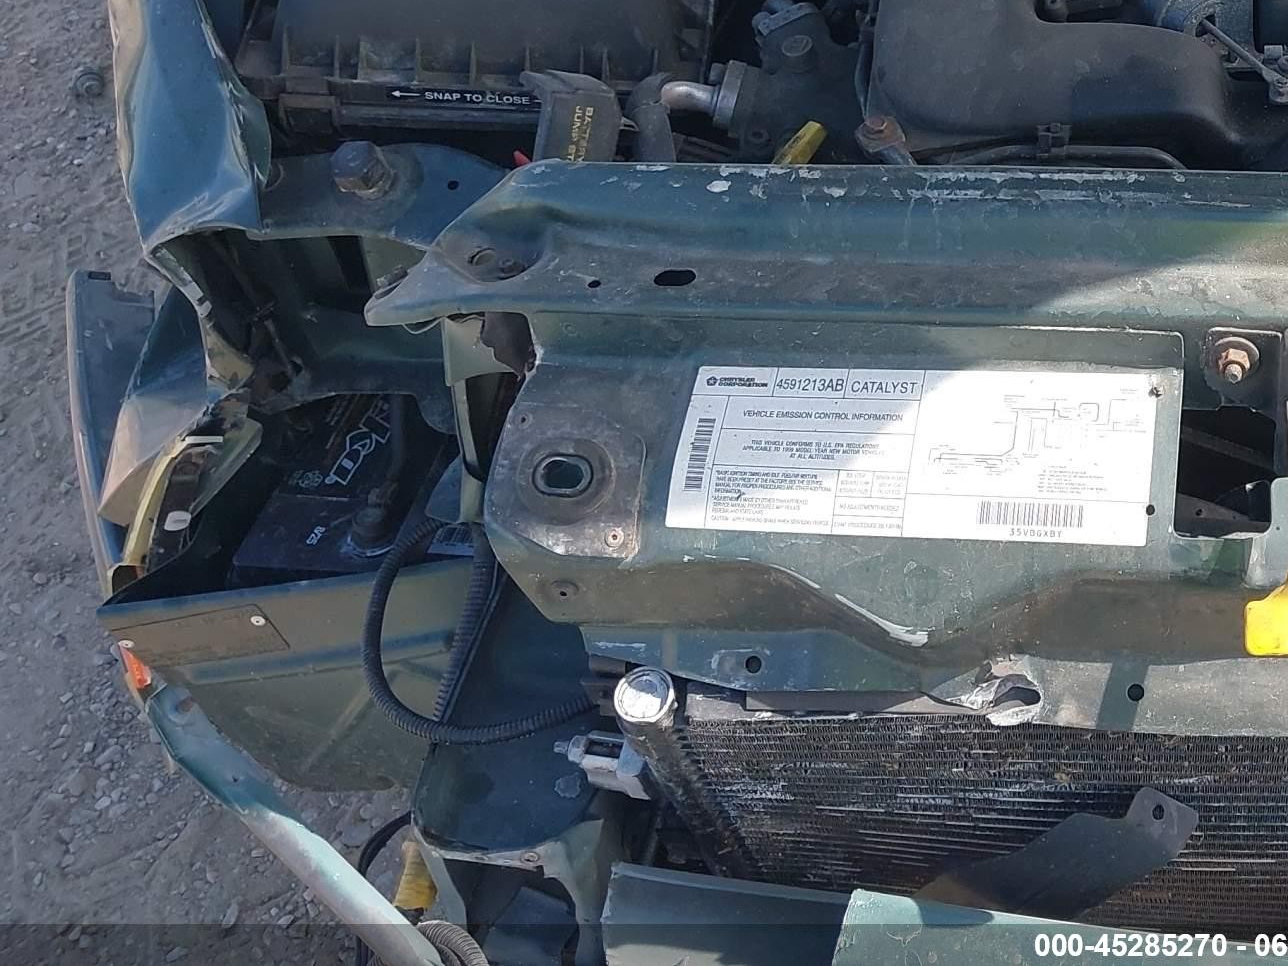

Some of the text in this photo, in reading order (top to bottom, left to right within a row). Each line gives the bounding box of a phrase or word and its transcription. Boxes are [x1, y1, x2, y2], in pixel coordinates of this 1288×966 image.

[424, 91, 532, 105] SNAP TO CLOSE
[776, 378, 846, 392] 4591213AB
[851, 381, 919, 394] CATALYST
[743, 410, 904, 422] VEHICLE EMISSION CONTROL INFORMATION
